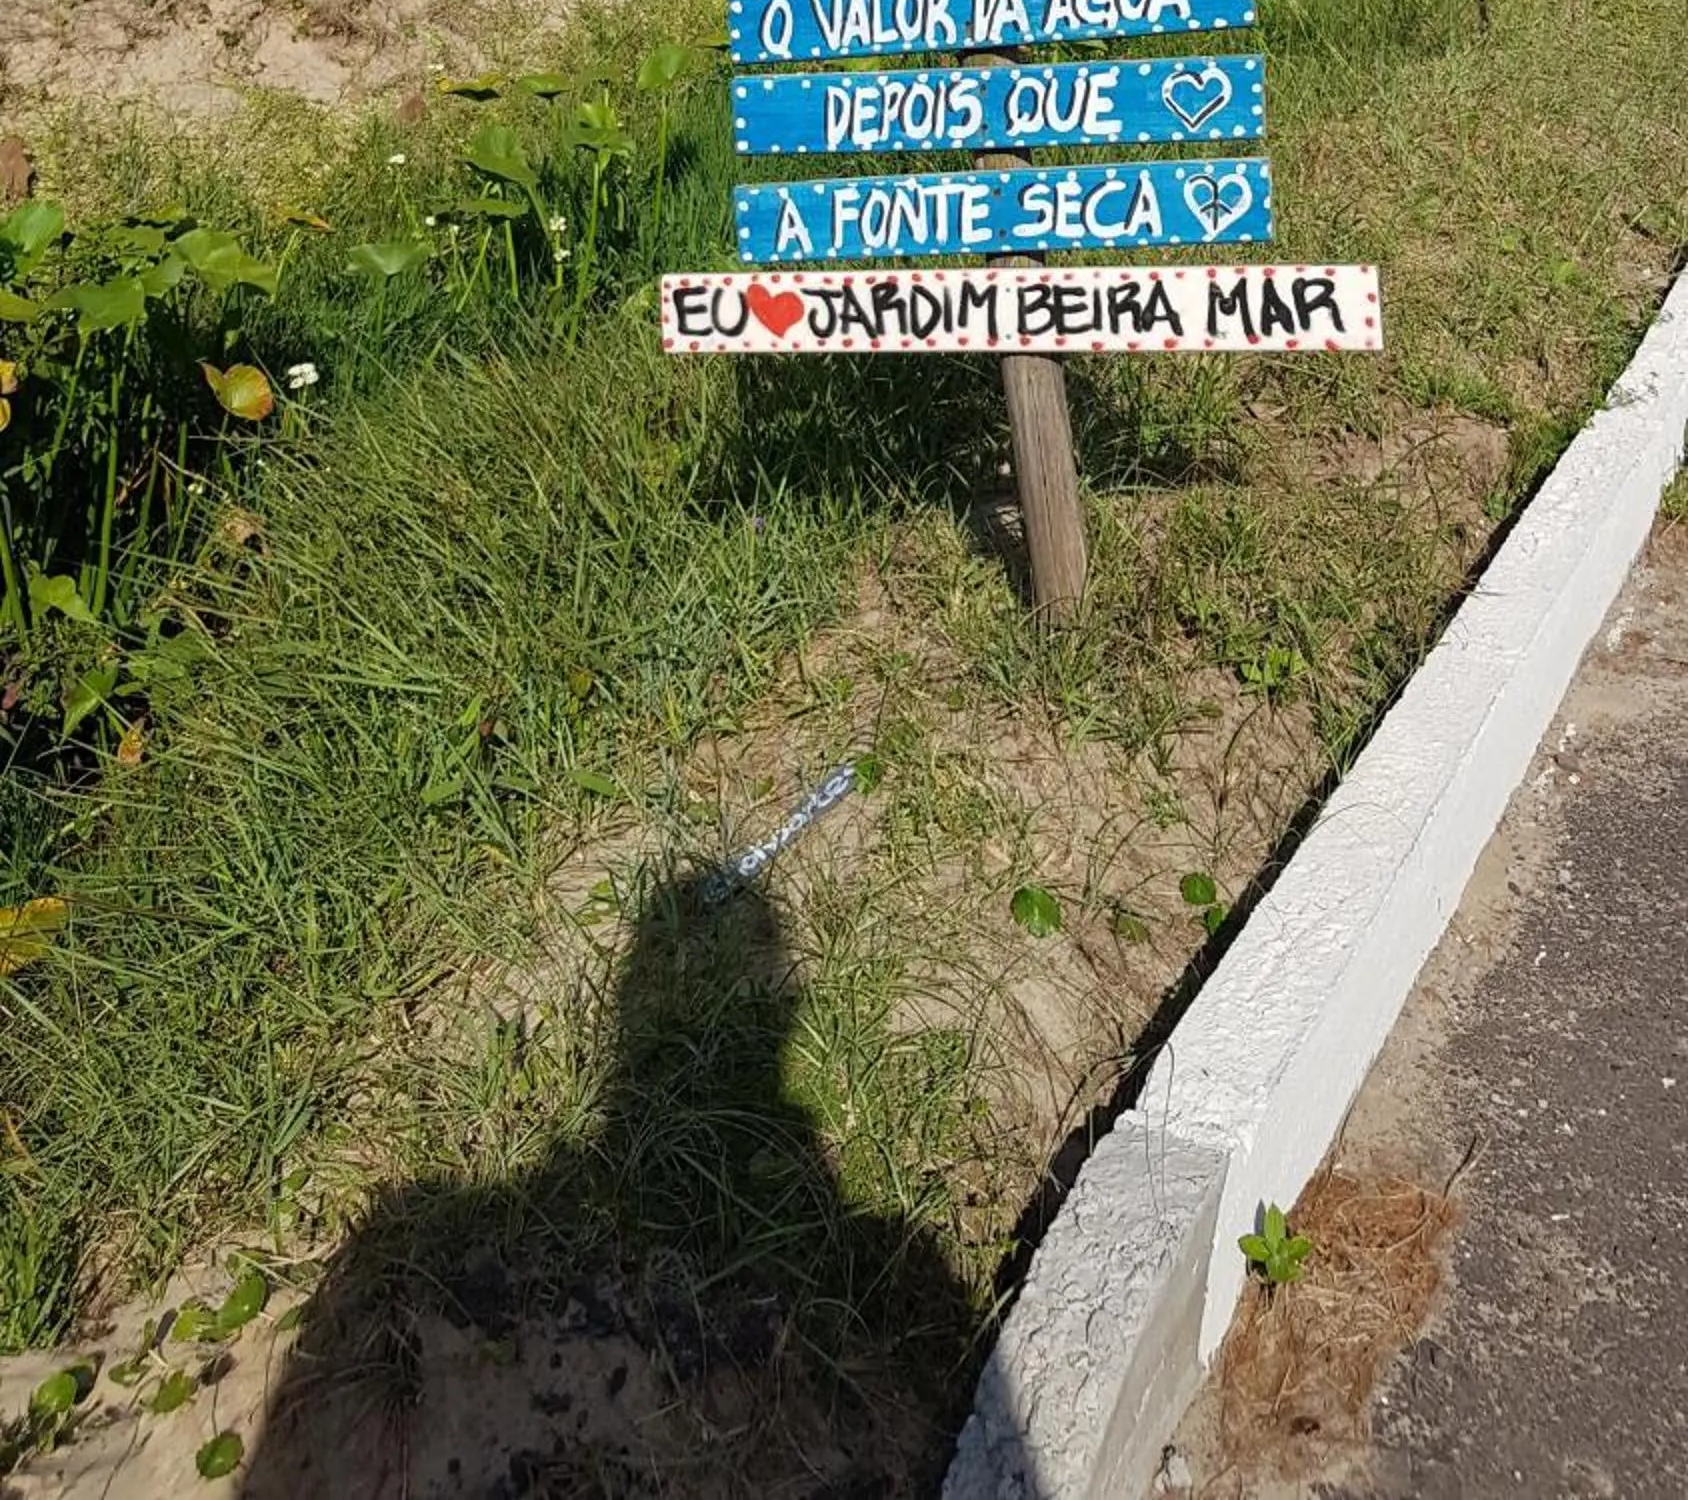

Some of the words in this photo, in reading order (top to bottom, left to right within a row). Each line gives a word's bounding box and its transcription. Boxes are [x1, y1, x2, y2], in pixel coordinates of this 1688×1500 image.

[826, 76, 984, 147] DEPOIS
[1005, 71, 1123, 137] QUE
[775, 196, 814, 254] A
[832, 183, 993, 250] FONTE
[1011, 175, 1163, 241] SECA
[672, 286, 749, 338] EU
[801, 282, 1000, 339] JARDIM
[1017, 280, 1184, 337] BEIRA
[1206, 277, 1346, 336] MAR
